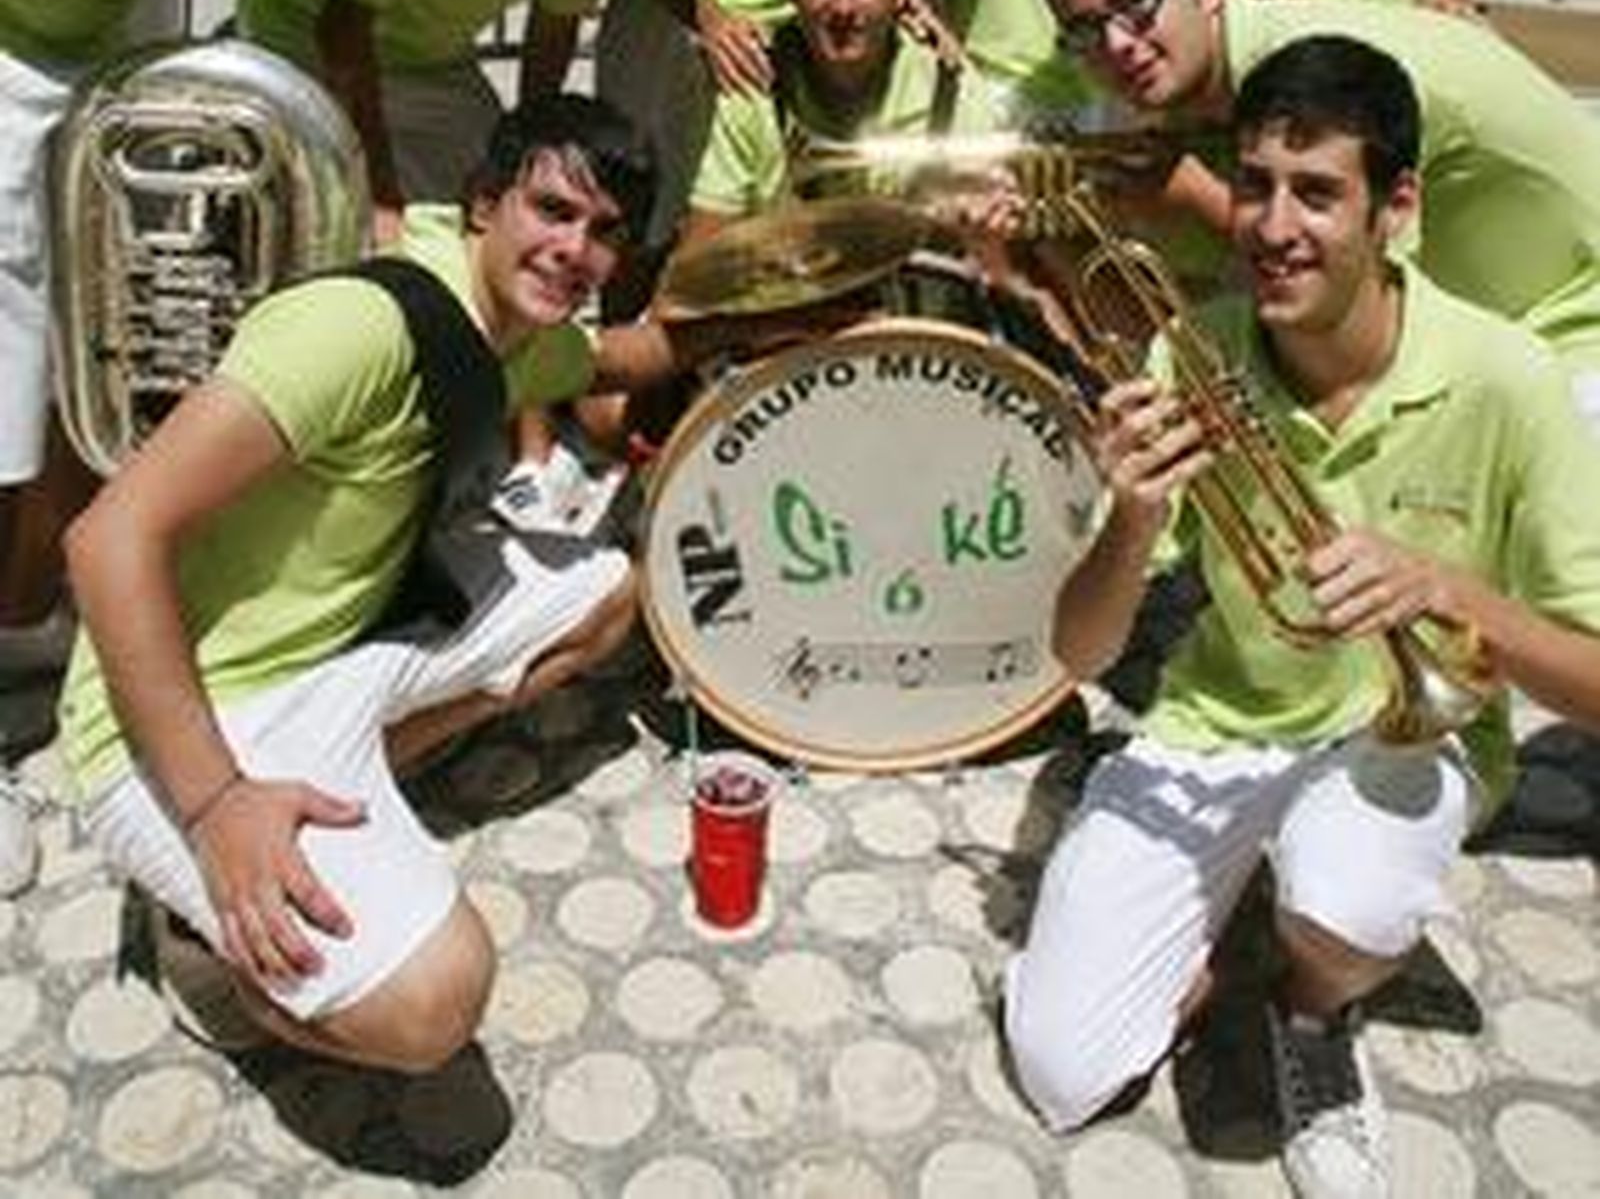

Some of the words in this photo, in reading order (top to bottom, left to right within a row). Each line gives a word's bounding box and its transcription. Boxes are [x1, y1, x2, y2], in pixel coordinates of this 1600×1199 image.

[713, 360, 857, 465] GRUPO
[875, 354, 1072, 464] MUSICAL
[773, 480, 853, 583] Si
